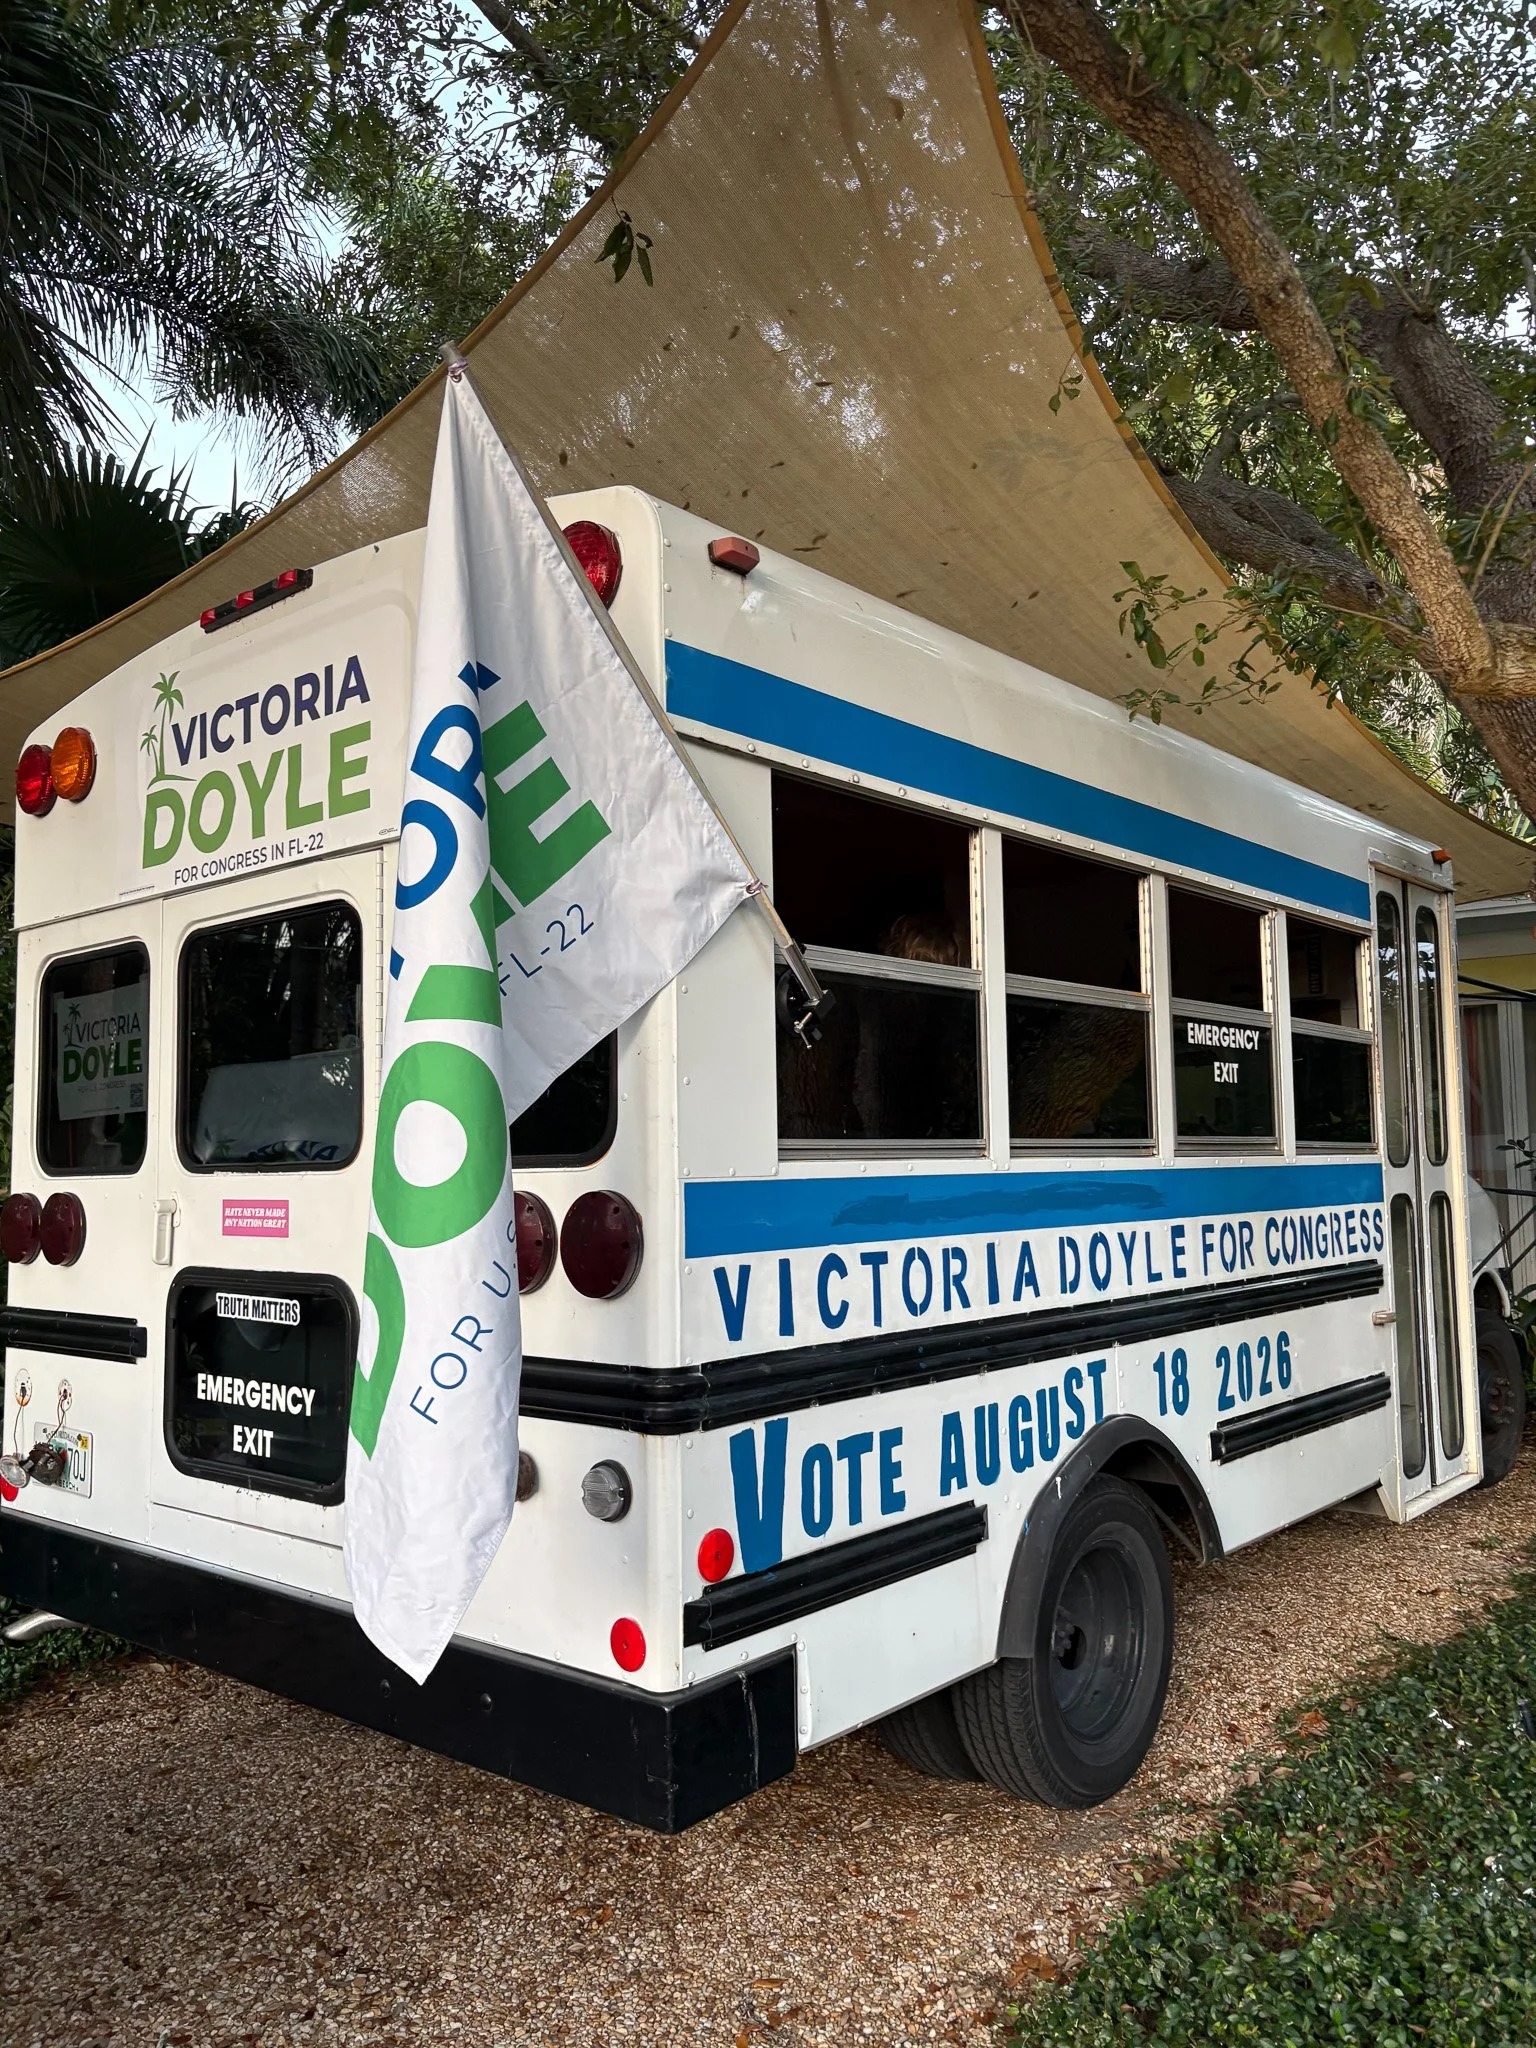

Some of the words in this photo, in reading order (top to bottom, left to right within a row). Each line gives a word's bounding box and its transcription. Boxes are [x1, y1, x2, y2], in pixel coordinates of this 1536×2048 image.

[171, 655, 371, 767] VICTORIA
[142, 720, 371, 869] DOYLE
[174, 865, 198, 885] FOR
[201, 847, 267, 878] CONGRESS
[271, 842, 284, 861] IN
[288, 832, 324, 857] FL-22
[498, 904, 594, 997] FL-22
[76, 1012, 142, 1043] VICTORIA
[1187, 1022, 1260, 1051] EMERGENCY
[63, 1038, 143, 1085] DOYLE
[1213, 1061, 1239, 1084] EXIT
[224, 1207, 243, 1217] HATE
[243, 1207, 265, 1217] NEVER
[265, 1208, 287, 1218] MADE
[224, 1218, 238, 1227] ANY
[238, 1218, 263, 1228] NATION
[263, 1218, 287, 1229] GREAT
[713, 1240, 1041, 1342] VICTORIA
[1058, 1223, 1187, 1295] DOYLE
[1202, 1221, 1255, 1276] FOR
[1265, 1208, 1384, 1267] CONGRESS
[218, 1295, 249, 1318] TRUTH
[252, 1299, 298, 1323] MATTERS
[409, 1315, 494, 1425] FOR
[197, 1372, 316, 1417] EMERGENCY
[233, 1424, 274, 1458] EXIT
[729, 1417, 906, 1574] VOTE
[939, 1359, 1107, 1497] AUGUST
[1153, 1348, 1190, 1417] 18
[1216, 1330, 1292, 1412] 2026
[67, 1446, 87, 1482] 70J
